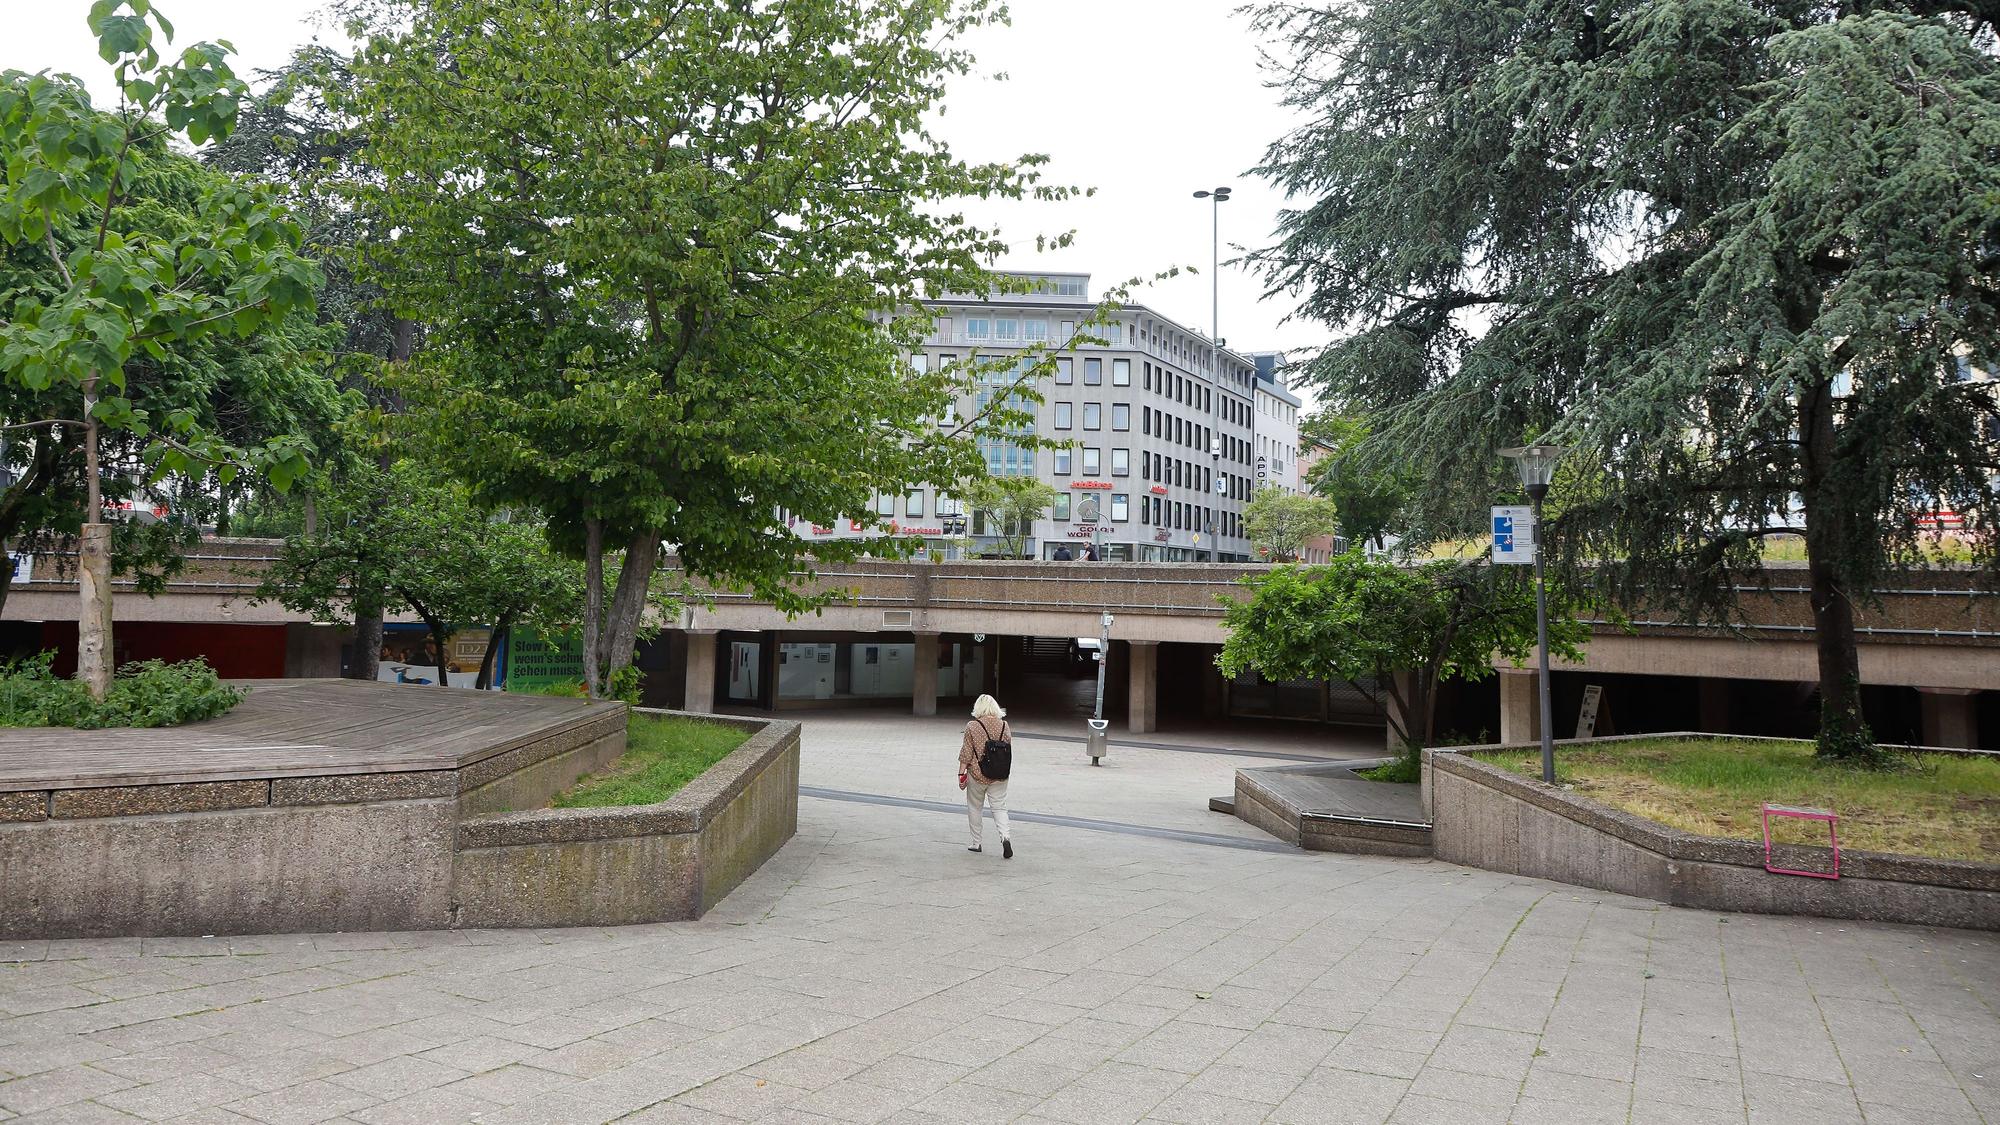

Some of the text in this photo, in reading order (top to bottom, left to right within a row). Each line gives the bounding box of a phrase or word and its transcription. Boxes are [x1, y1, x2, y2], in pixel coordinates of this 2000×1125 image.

[903, 526, 942, 536] Sparkasse
[515, 640, 574, 652] Slow Fod.
[555, 653, 584, 664] schne
[513, 665, 582, 679] gehen muss.
